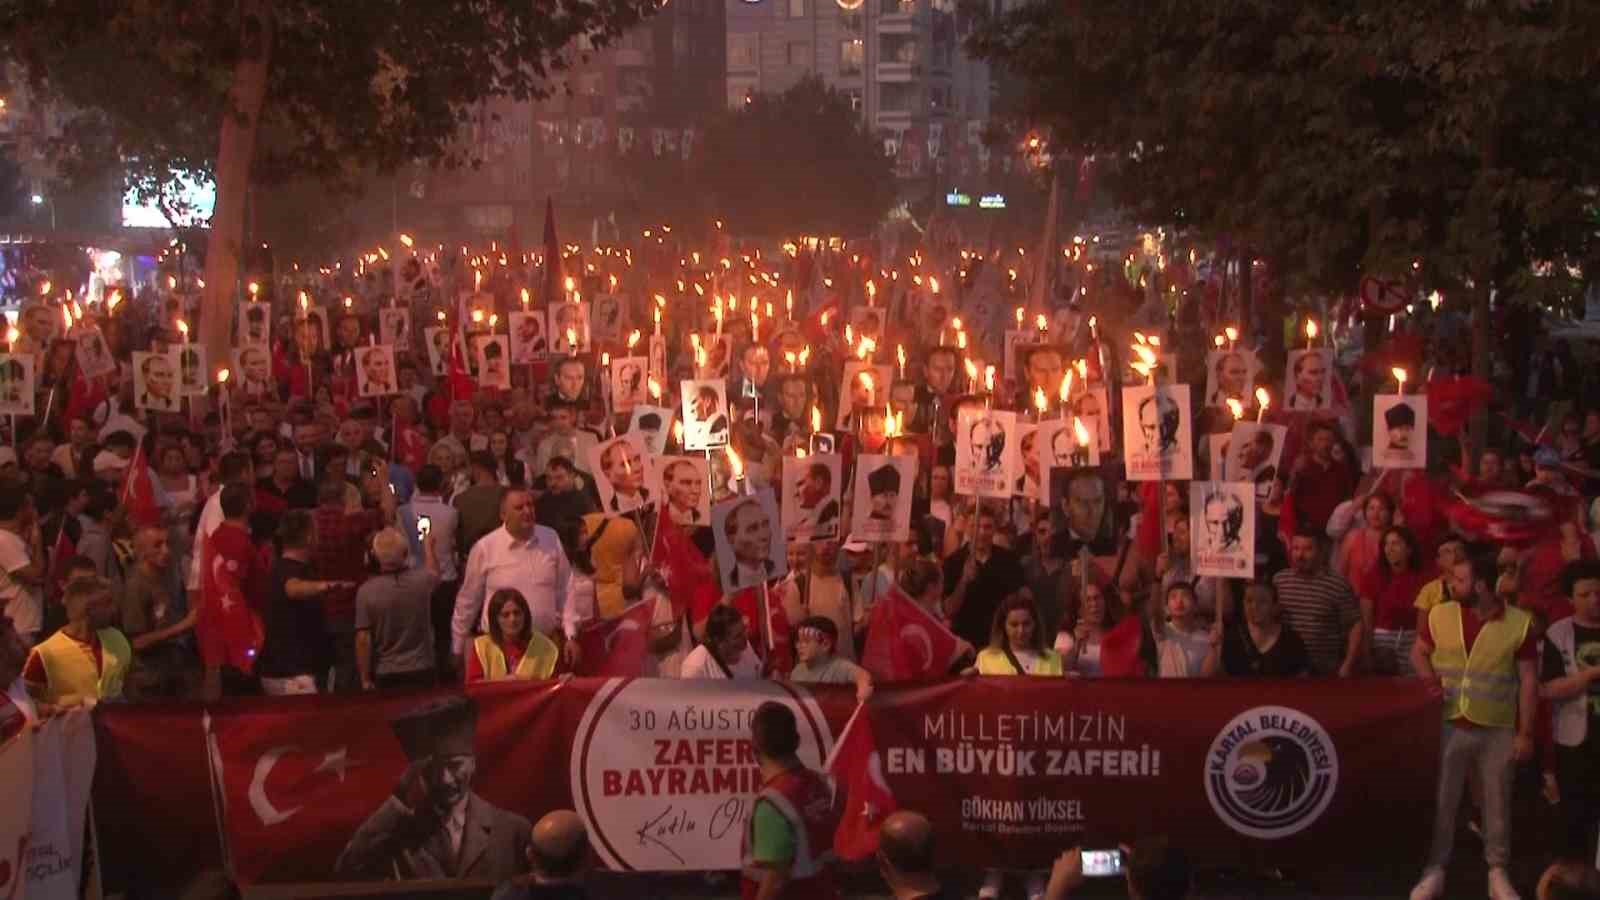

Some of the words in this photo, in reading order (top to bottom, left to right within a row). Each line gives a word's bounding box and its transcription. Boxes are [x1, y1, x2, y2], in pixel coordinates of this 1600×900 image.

[629, 709, 656, 731] 30
[924, 710, 1126, 742] MİLLETİMİZİN
[654, 738, 757, 765] ZAFER
[1209, 720, 1257, 771] KARTAL
[1259, 714, 1332, 770] BELEDİYESİ
[887, 747, 925, 774] EN
[936, 743, 1037, 776] BÜYÜK
[1045, 744, 1161, 777] ZAFERİ!
[708, 797, 745, 840] Ol
[960, 795, 1024, 821] GÖKHAN
[1027, 796, 1086, 821] YÜKSEL
